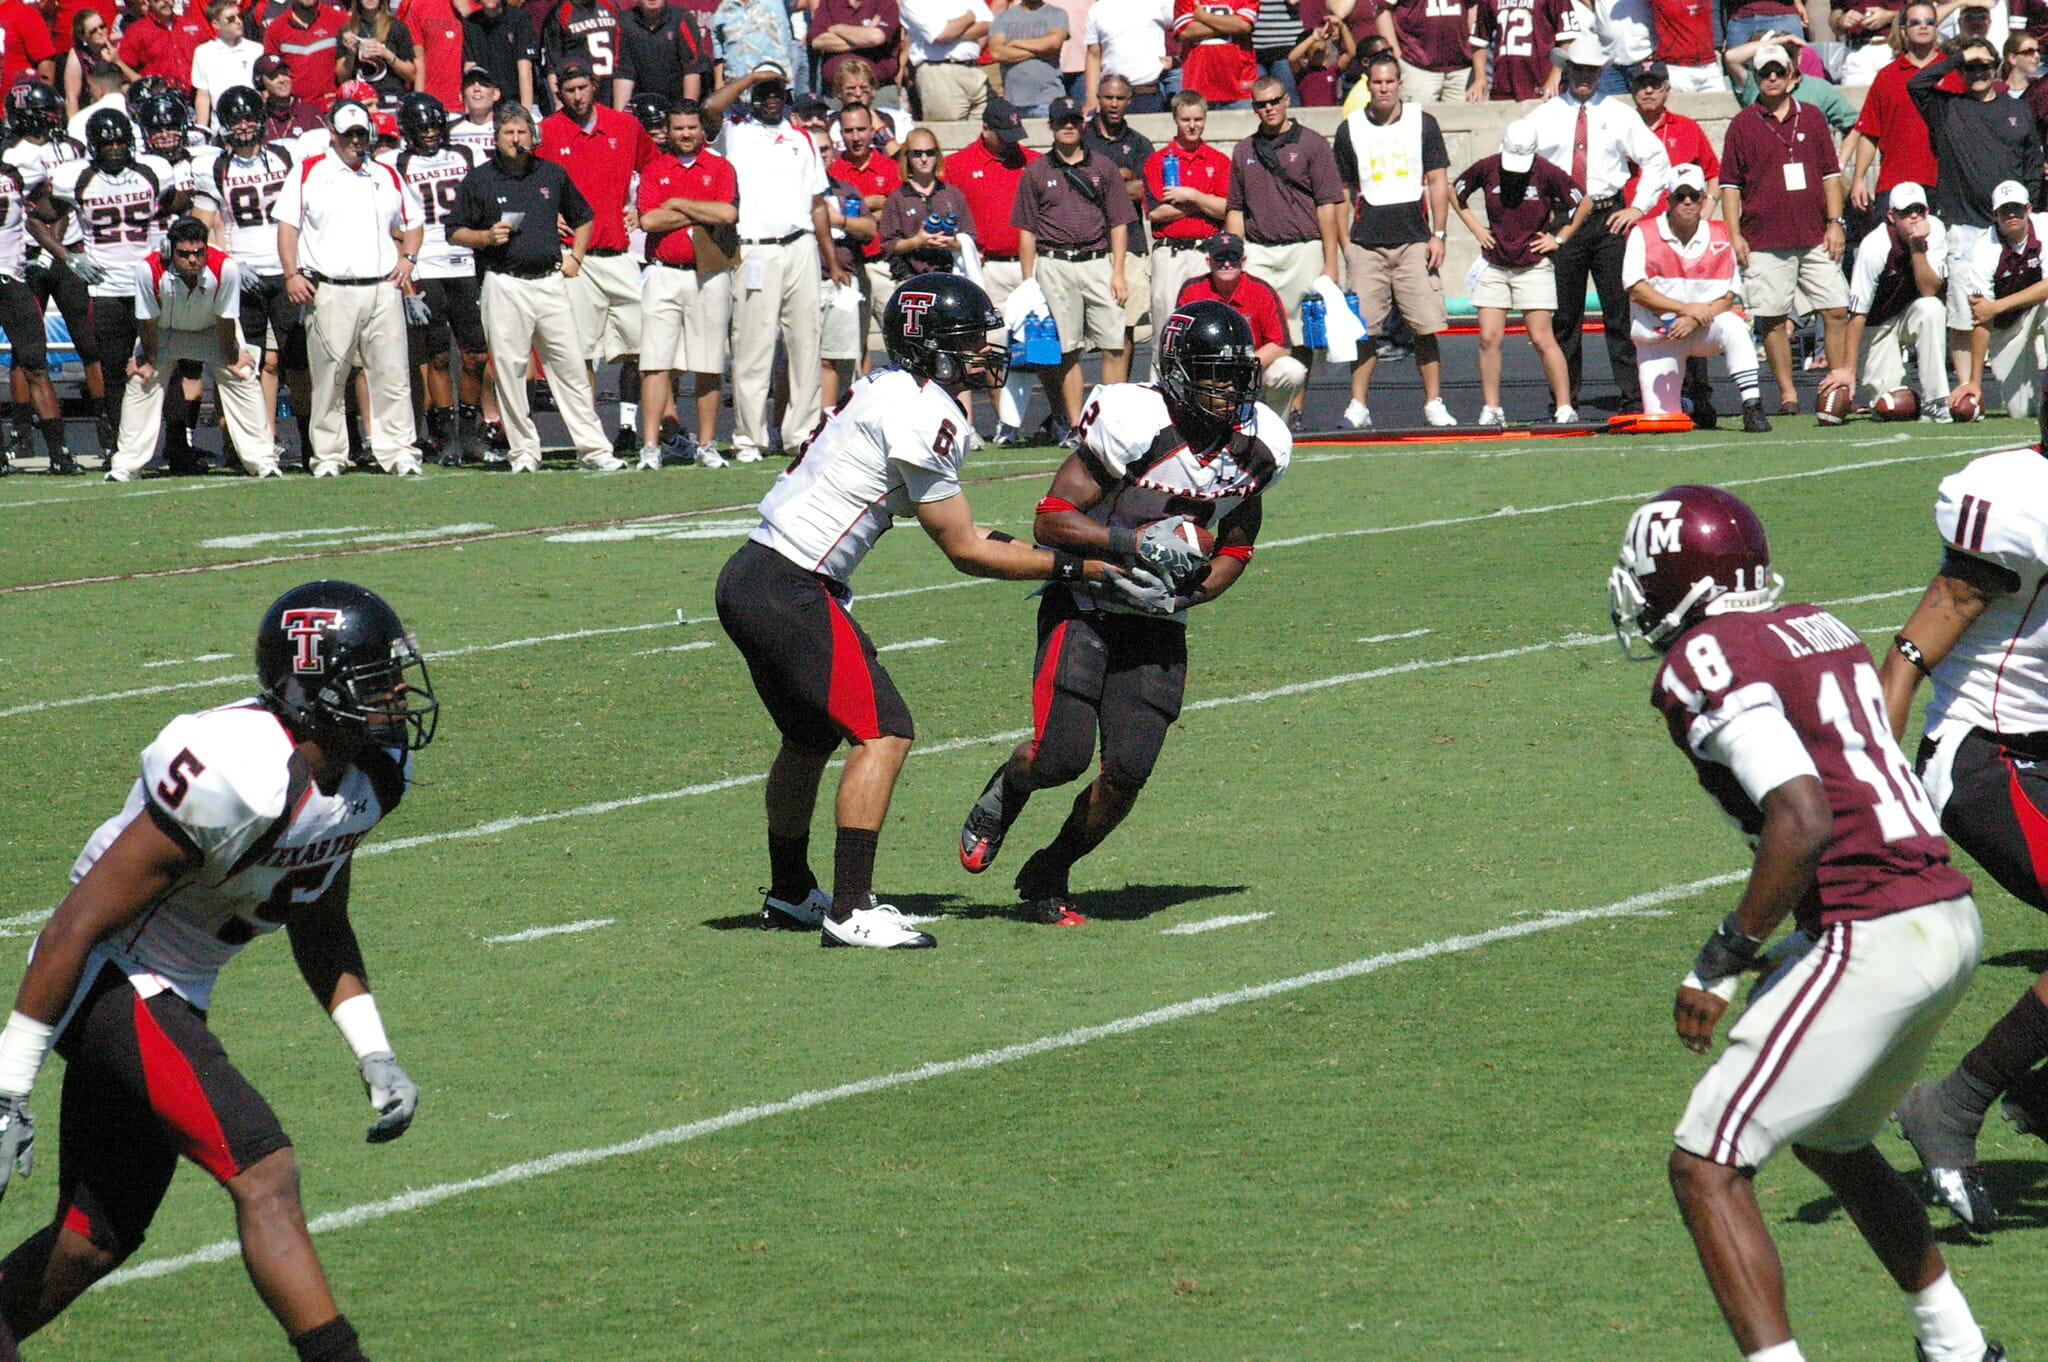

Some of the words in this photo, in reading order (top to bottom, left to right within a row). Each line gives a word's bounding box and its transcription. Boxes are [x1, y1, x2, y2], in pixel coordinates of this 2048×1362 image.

[587, 31, 613, 76] 5
[1496, 8, 1533, 56] 12
[225, 175, 261, 187] TEXAS
[405, 169, 440, 184] TEXAS
[83, 196, 122, 208] TEXAS
[124, 190, 152, 203] TECH
[92, 202, 152, 245] 25
[932, 418, 957, 457] 6
[1954, 493, 1992, 552] 11
[1735, 565, 1765, 593] 18
[1661, 633, 1733, 714] 18
[1816, 662, 1943, 843] 18
[157, 747, 206, 811] 5
